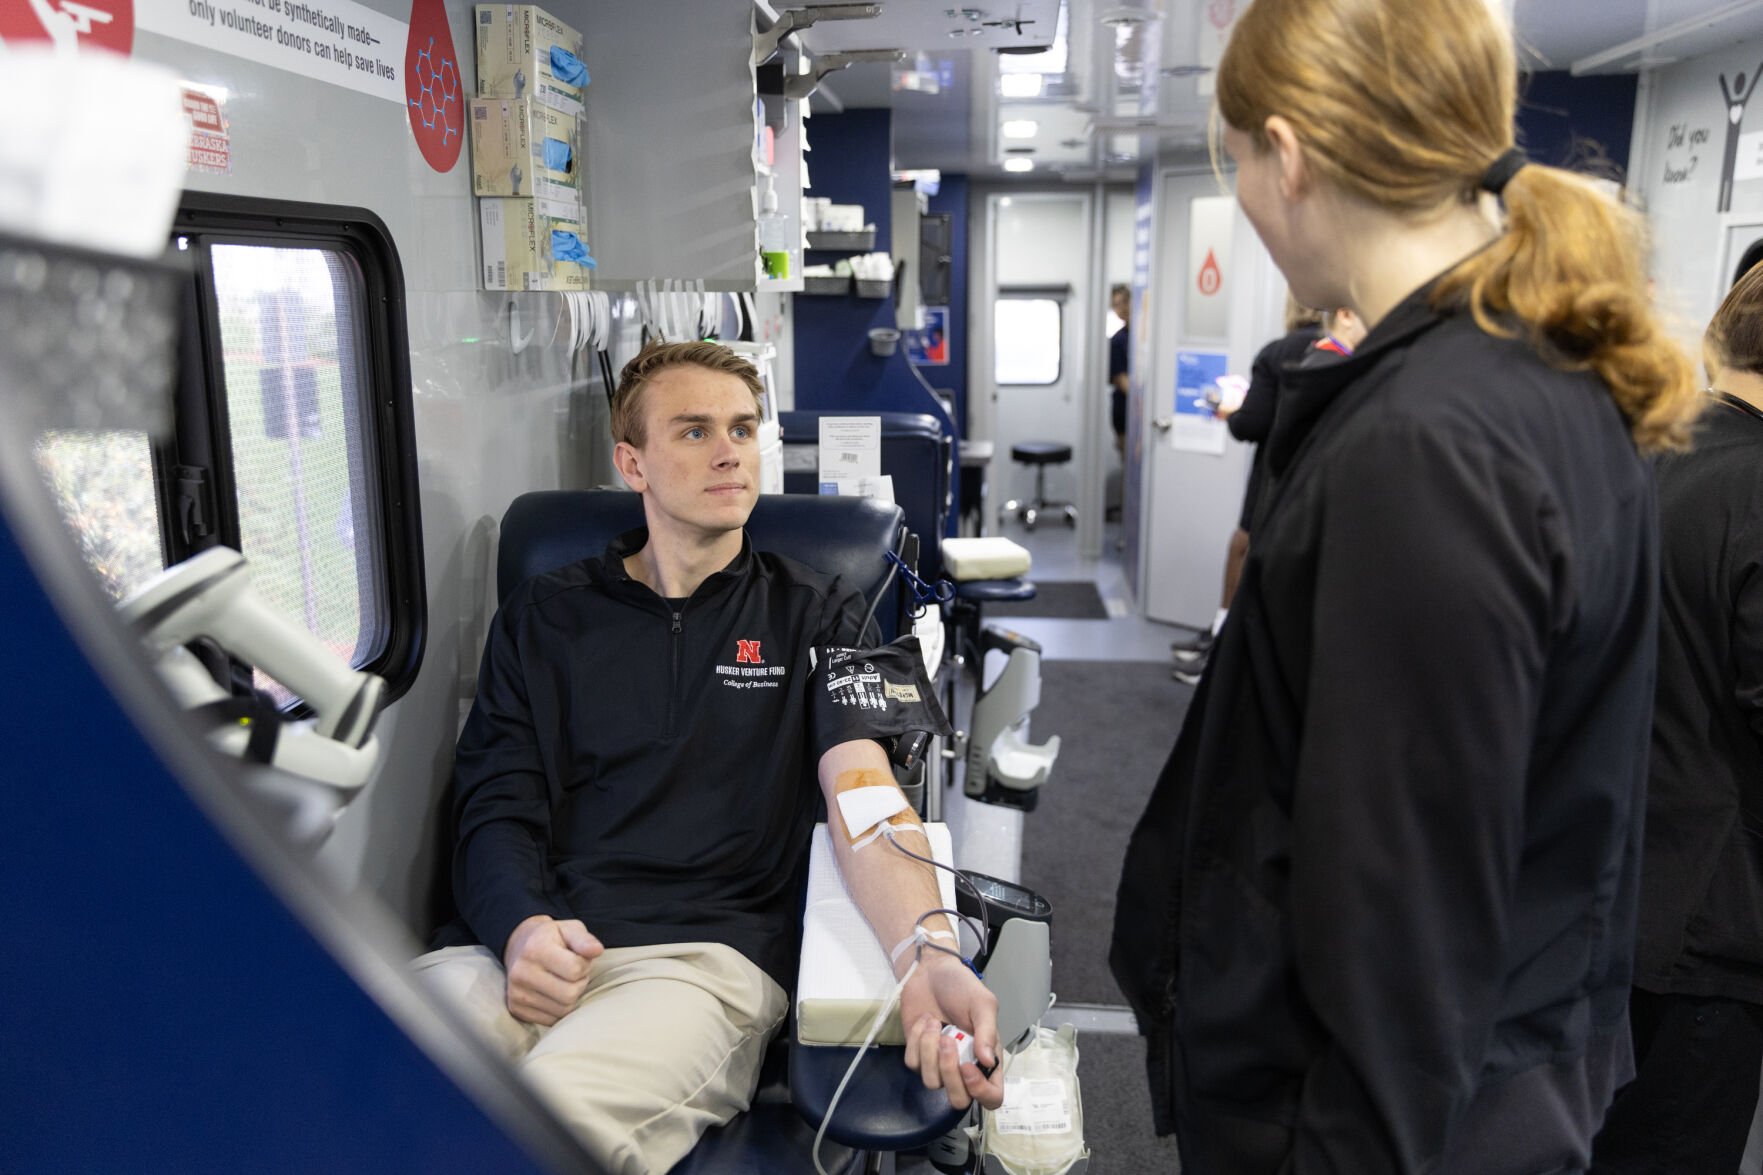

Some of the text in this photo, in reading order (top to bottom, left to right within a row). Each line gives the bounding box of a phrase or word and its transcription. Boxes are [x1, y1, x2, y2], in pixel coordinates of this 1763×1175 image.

[284, 1, 344, 40] synthetically
[189, 0, 394, 80] only volunteer donors can help save lives
[736, 639, 762, 664] N
[716, 664, 786, 677] HUSKER VENTURE FUND
[723, 679, 744, 689] College
[745, 681, 752, 689] of
